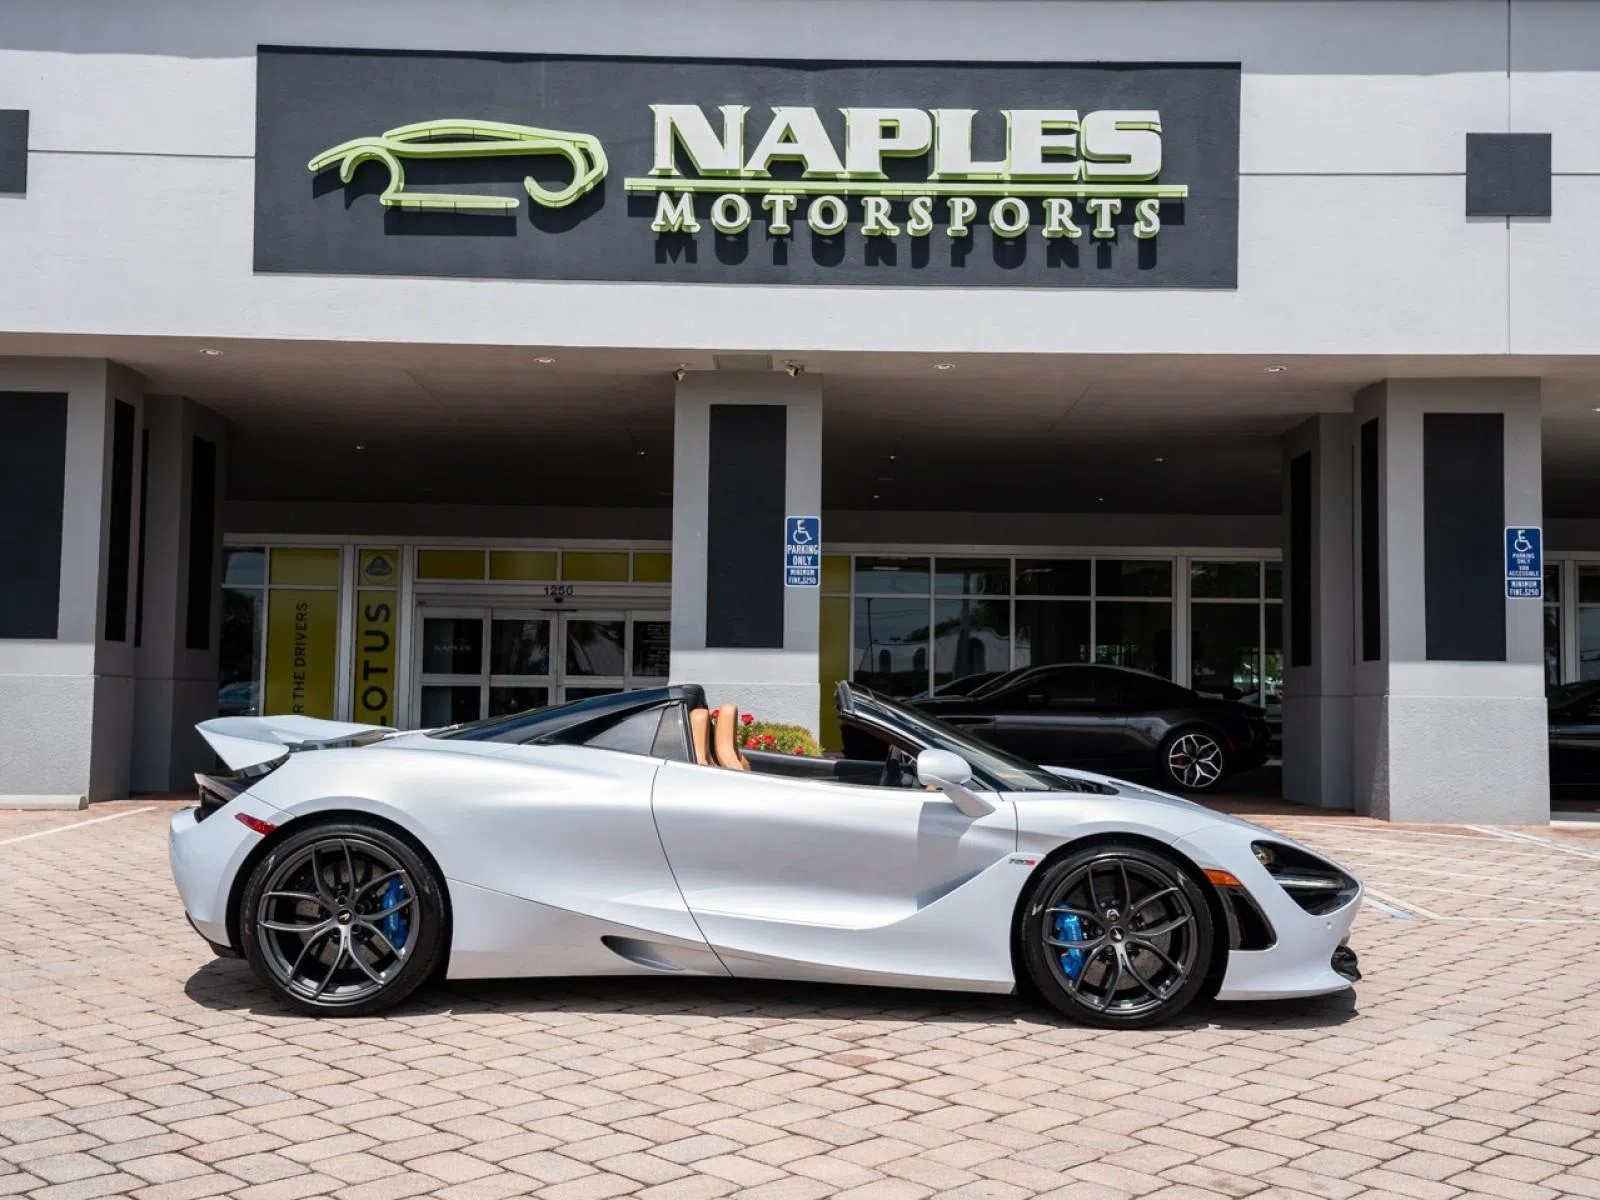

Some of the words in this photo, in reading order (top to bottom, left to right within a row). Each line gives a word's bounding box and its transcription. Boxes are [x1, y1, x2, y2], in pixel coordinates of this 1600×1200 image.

[649, 104, 1162, 181] NAPLES
[651, 192, 1161, 238] MOTORSPORTS
[787, 544, 819, 554] PARKING
[792, 555, 813, 566] ONLY
[544, 585, 574, 596] 1250
[294, 602, 308, 667] DRIVERS
[361, 602, 391, 727] OTUS
[292, 671, 305, 700] THE
